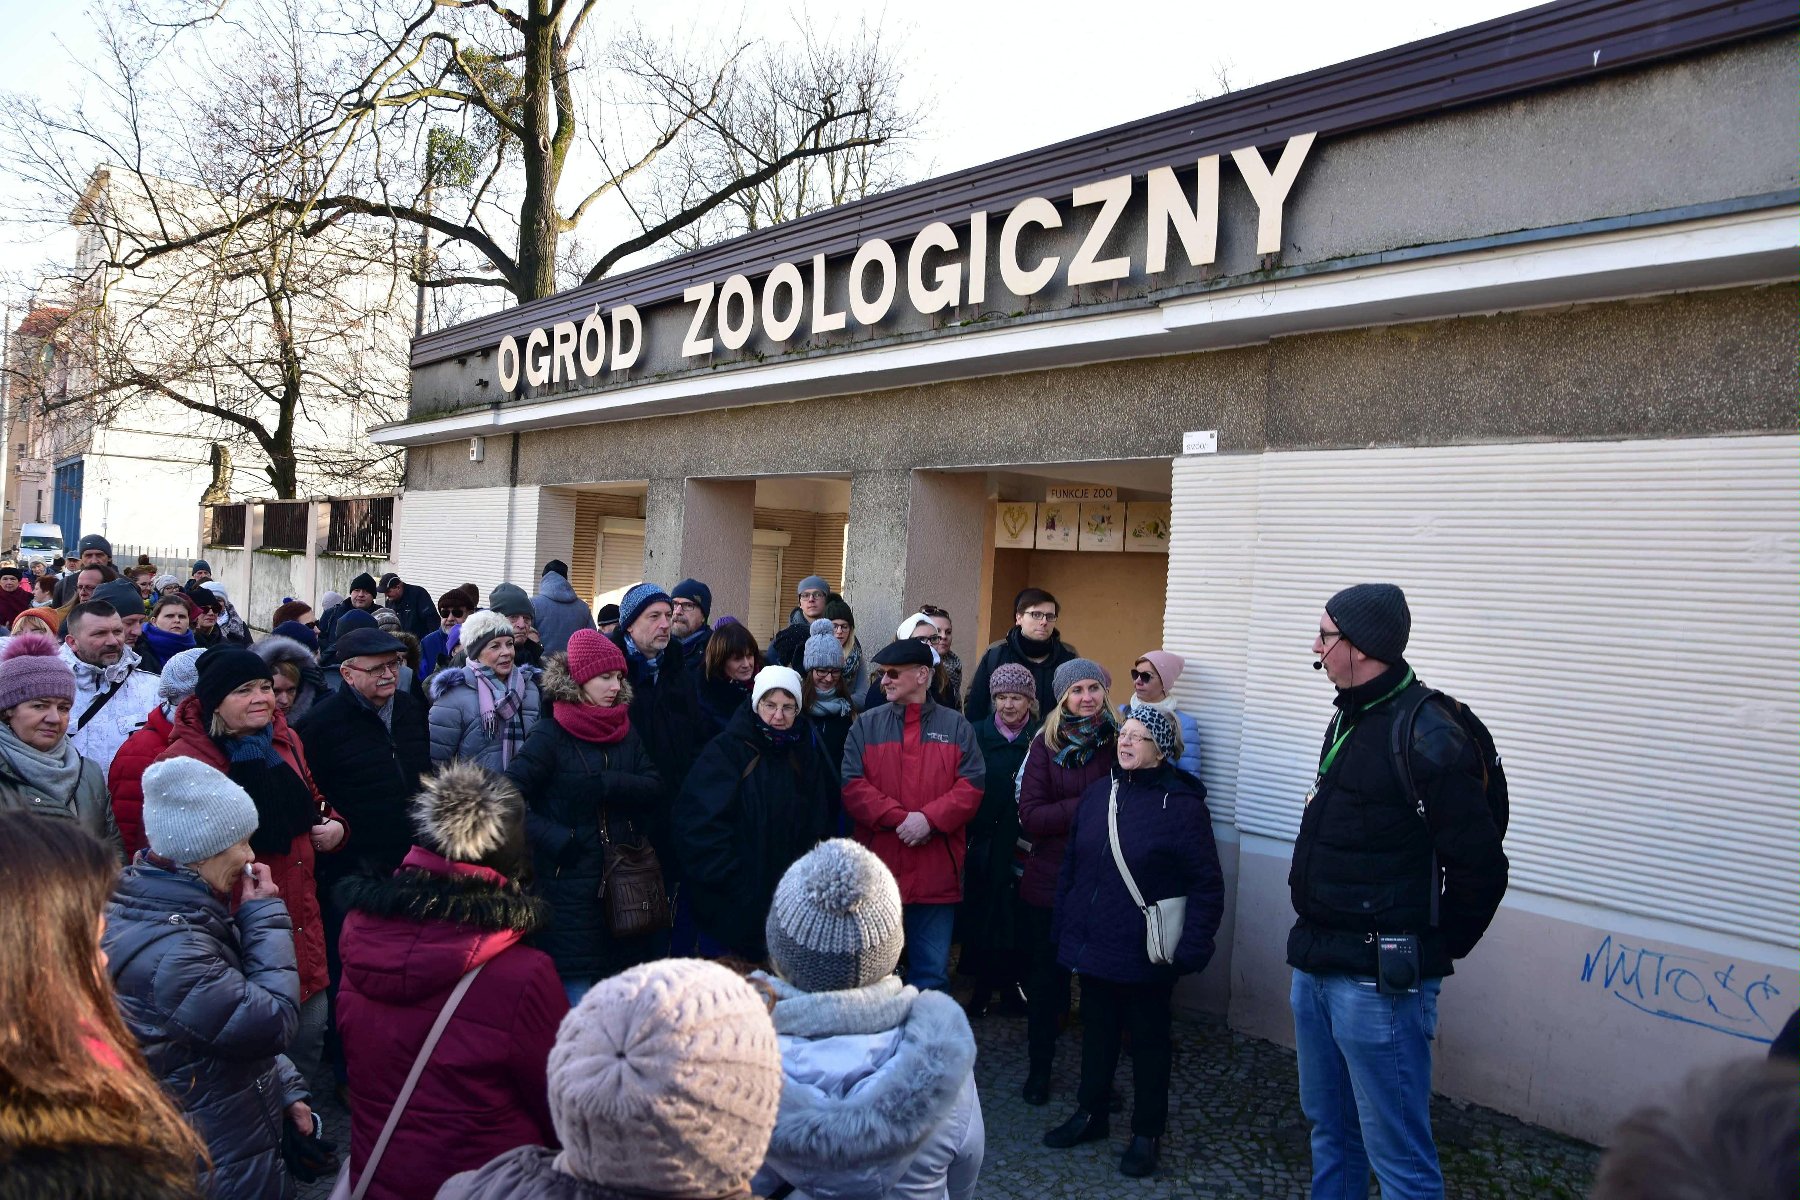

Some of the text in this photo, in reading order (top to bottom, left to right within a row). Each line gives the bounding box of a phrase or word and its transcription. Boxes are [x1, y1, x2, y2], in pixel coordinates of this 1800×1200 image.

[497, 131, 1318, 393] OGRÓD ZOOLOGICZNY
[1051, 488, 1113, 499] FUNKCJE ZOO
